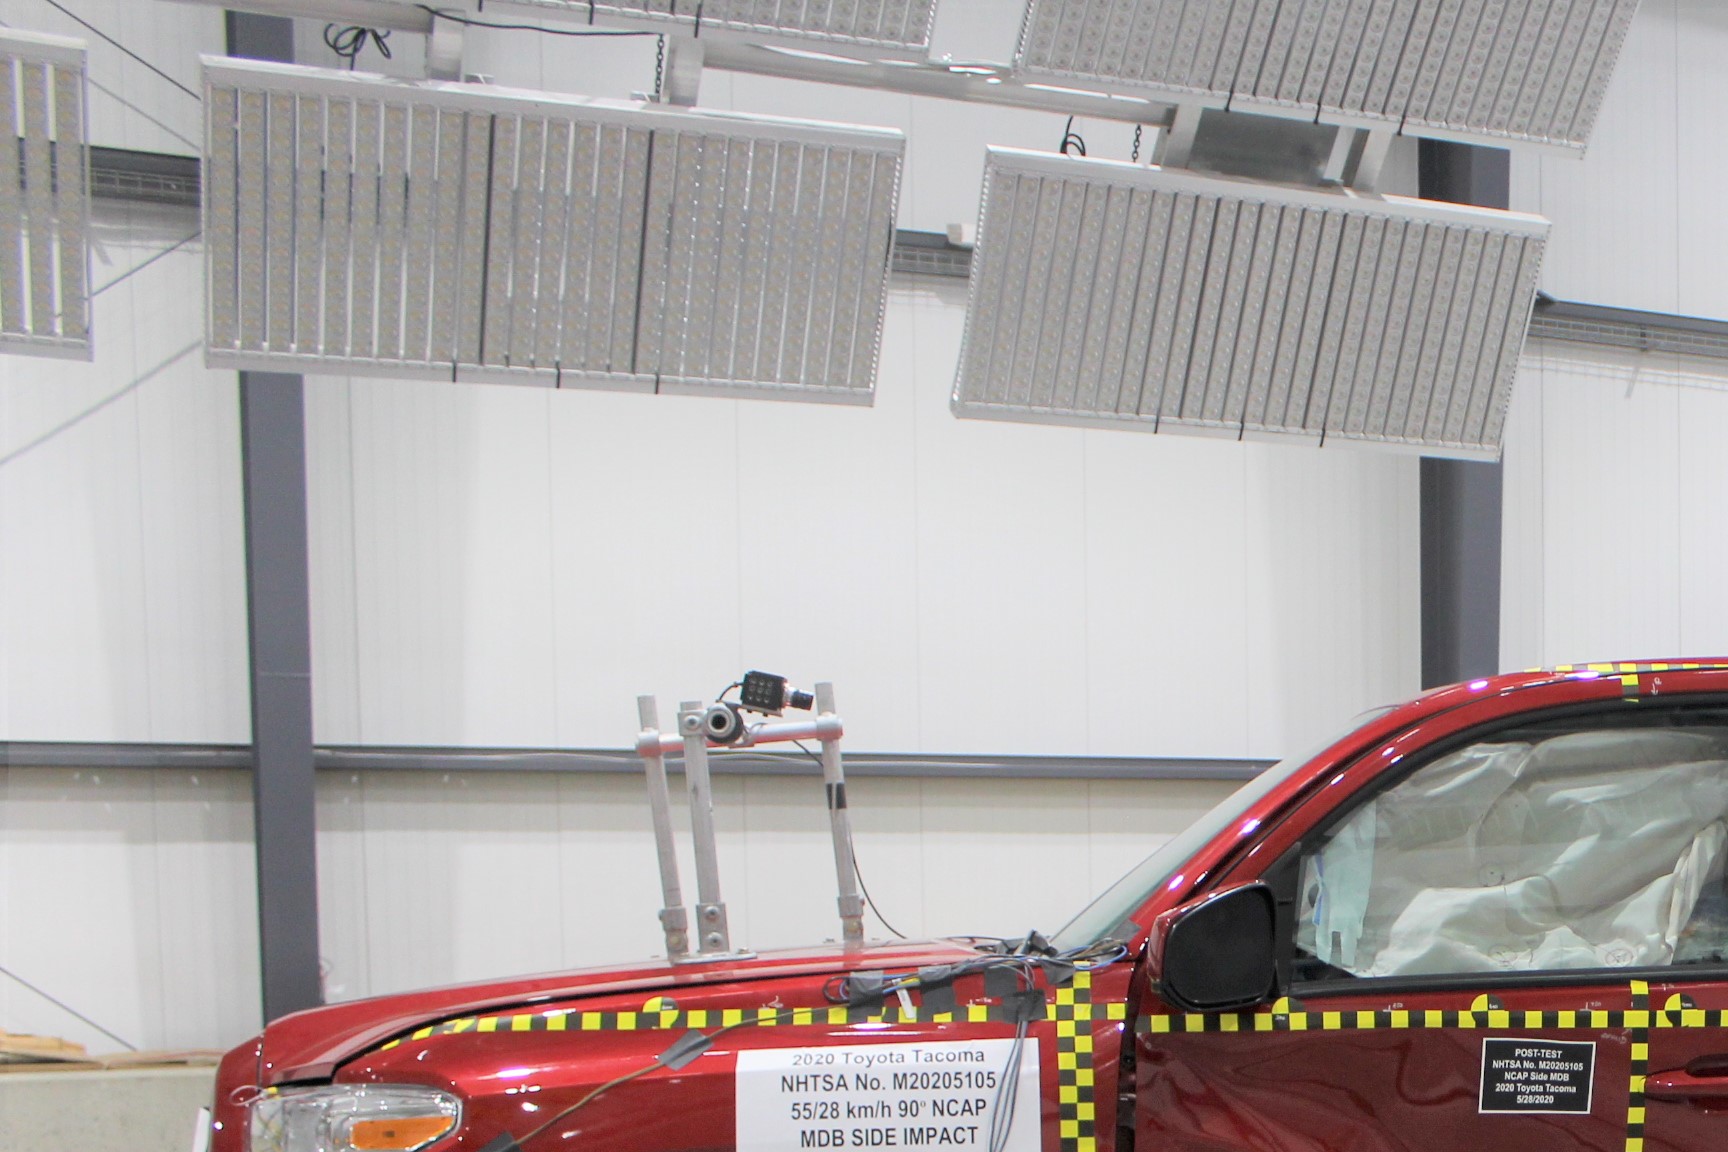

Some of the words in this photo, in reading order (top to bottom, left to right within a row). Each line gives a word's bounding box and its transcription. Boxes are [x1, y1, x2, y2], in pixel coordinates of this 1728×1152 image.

[793, 1053, 834, 1066] 2020
[842, 1051, 905, 1068] Toyota
[913, 1049, 985, 1063] Tacoma
[1515, 1049, 1562, 1059] POST-TEST
[1493, 1060, 1521, 1068] NHTSA
[1523, 1061, 1536, 1069] No.
[1539, 1062, 1583, 1070] M20205105
[781, 1074, 848, 1092] NHTSA
[856, 1074, 886, 1091] No.
[893, 1072, 996, 1090] M20205105
[1550, 1073, 1569, 1081] MDB
[1517, 1084, 1543, 1093] Toyota
[1546, 1084, 1576, 1092] Tacoma
[791, 1101, 840, 1120] 55/28
[847, 1101, 891, 1118] km/h
[932, 1098, 987, 1116] NCAP
[800, 1130, 845, 1148] MDB
[852, 1128, 896, 1147] SIDE
[904, 1126, 978, 1145] IMPACT
